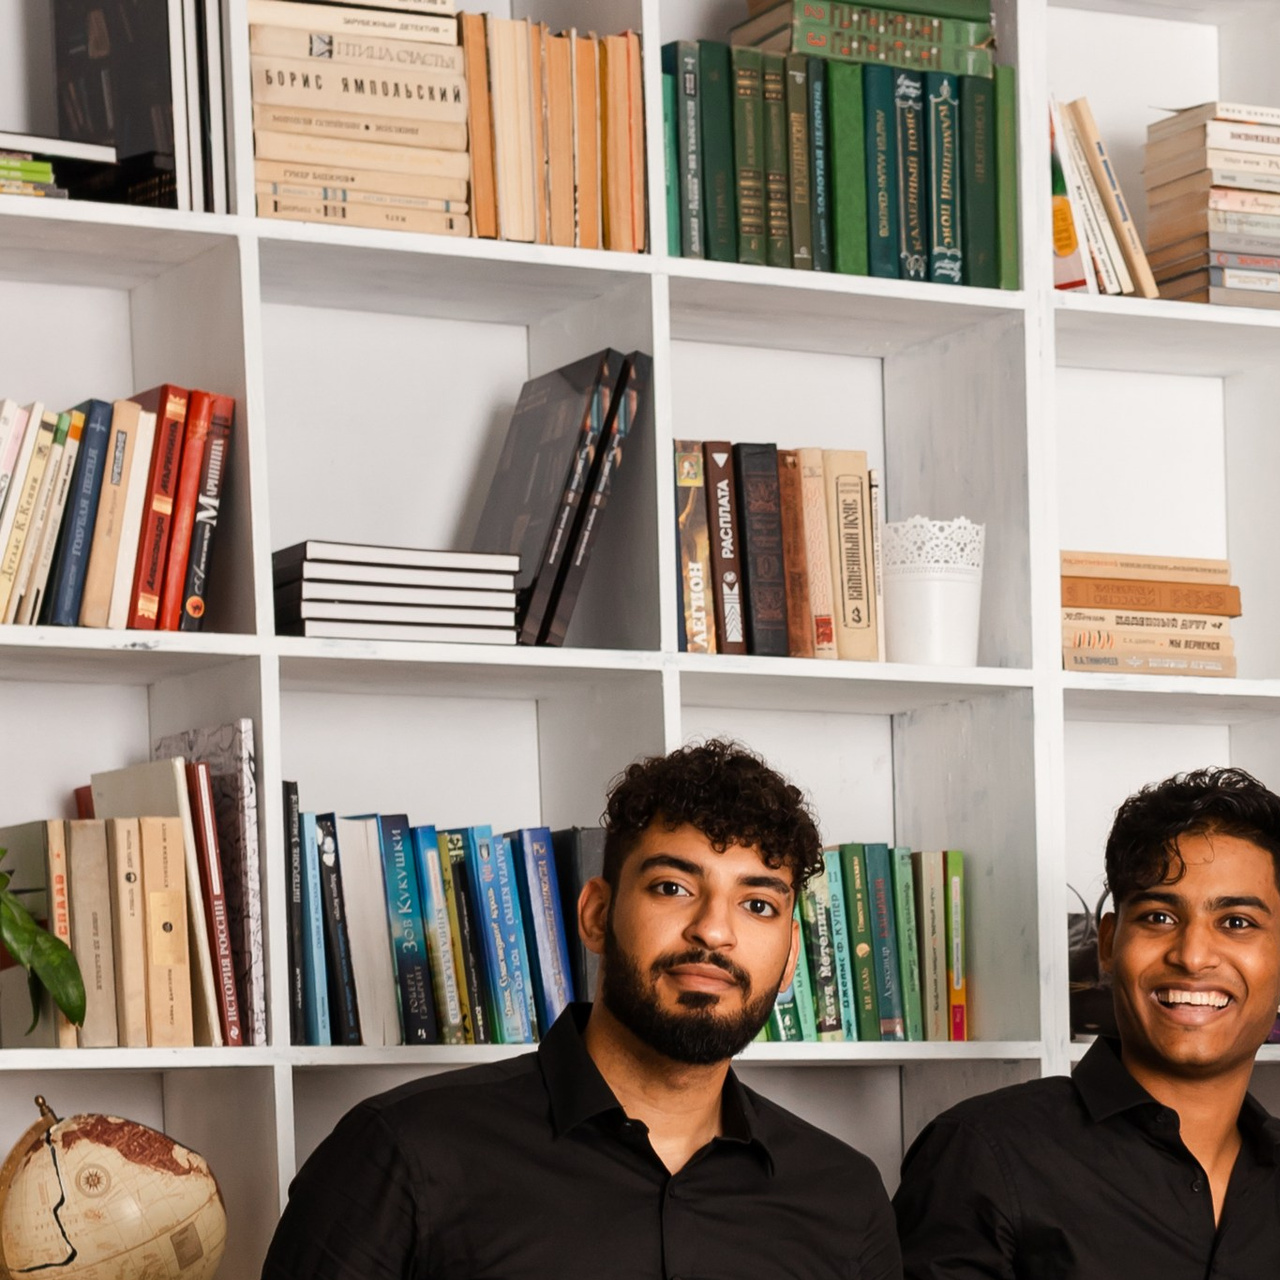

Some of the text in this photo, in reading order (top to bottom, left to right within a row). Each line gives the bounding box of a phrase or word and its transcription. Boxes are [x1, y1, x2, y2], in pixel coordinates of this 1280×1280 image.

[399, 21, 441, 34] ДЕТЕКТИВ
[806, 4, 825, 20] 2
[336, 41, 456, 70] ПТИЦА СЧАСТЬЯ
[806, 31, 827, 48] 3
[264, 69, 462, 105] БОРИС ЯМПОЛЬСКИЙ
[814, 148, 826, 214] ЗОЛОТАЯ
[905, 108, 922, 252] КАМЕННЫЙ ПОЯС
[937, 104, 953, 247] КАМЕННЫЙ ПОЯС
[72, 447, 99, 557] ГОЛУБАЯ ПЕСНЯ
[719, 478, 735, 559] РАСПЛАТА
[842, 498, 864, 601] КАМЕННЫЙ ПОЯС
[687, 561, 709, 649] ЛЕГИОН
[1168, 638, 1221, 651] МЫ ВЕРНЕМСЯ
[494, 842, 508, 884] МАРТА
[500, 886, 514, 926] КЕТРО
[831, 893, 843, 936] КУПЕР
[213, 898, 238, 1023] ИСТОРИЯ РОССИИ
[435, 907, 459, 1021] КНИГА БЛАЖЕНСТВ
[816, 896, 837, 1027] Катя Метелица
[858, 967, 871, 994] ДАЛЬ
[410, 972, 420, 1014] РОБЕРТ
